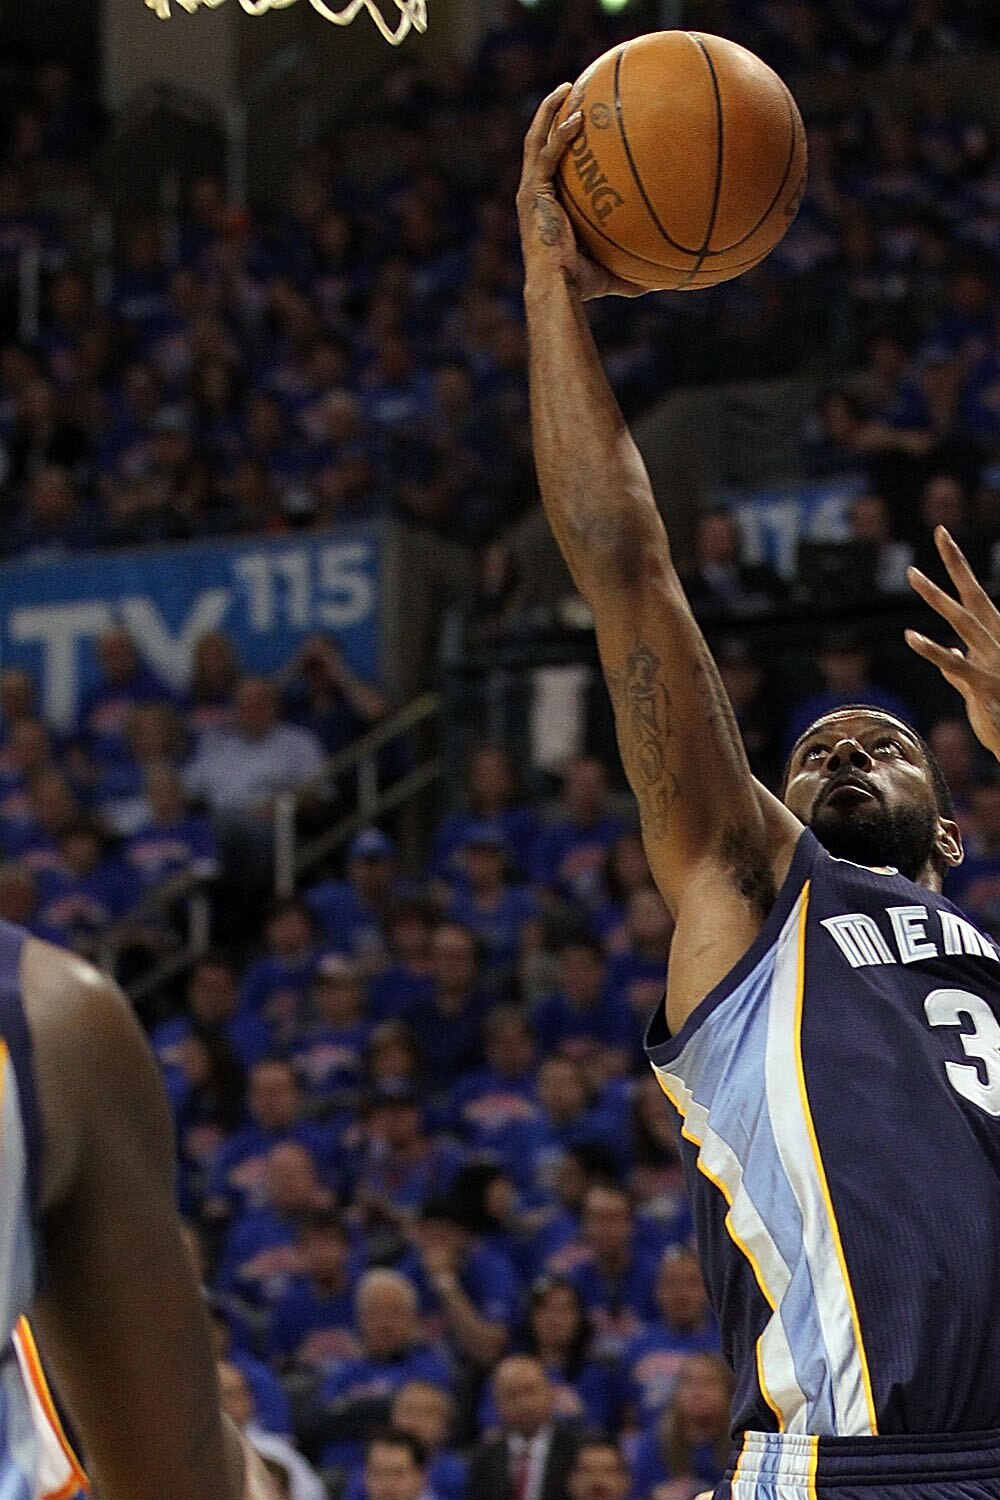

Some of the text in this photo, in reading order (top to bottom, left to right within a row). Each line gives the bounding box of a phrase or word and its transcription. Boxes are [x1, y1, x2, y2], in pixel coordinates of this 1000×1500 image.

[571, 130, 625, 221] DING
[10, 546, 375, 735] TV 115
